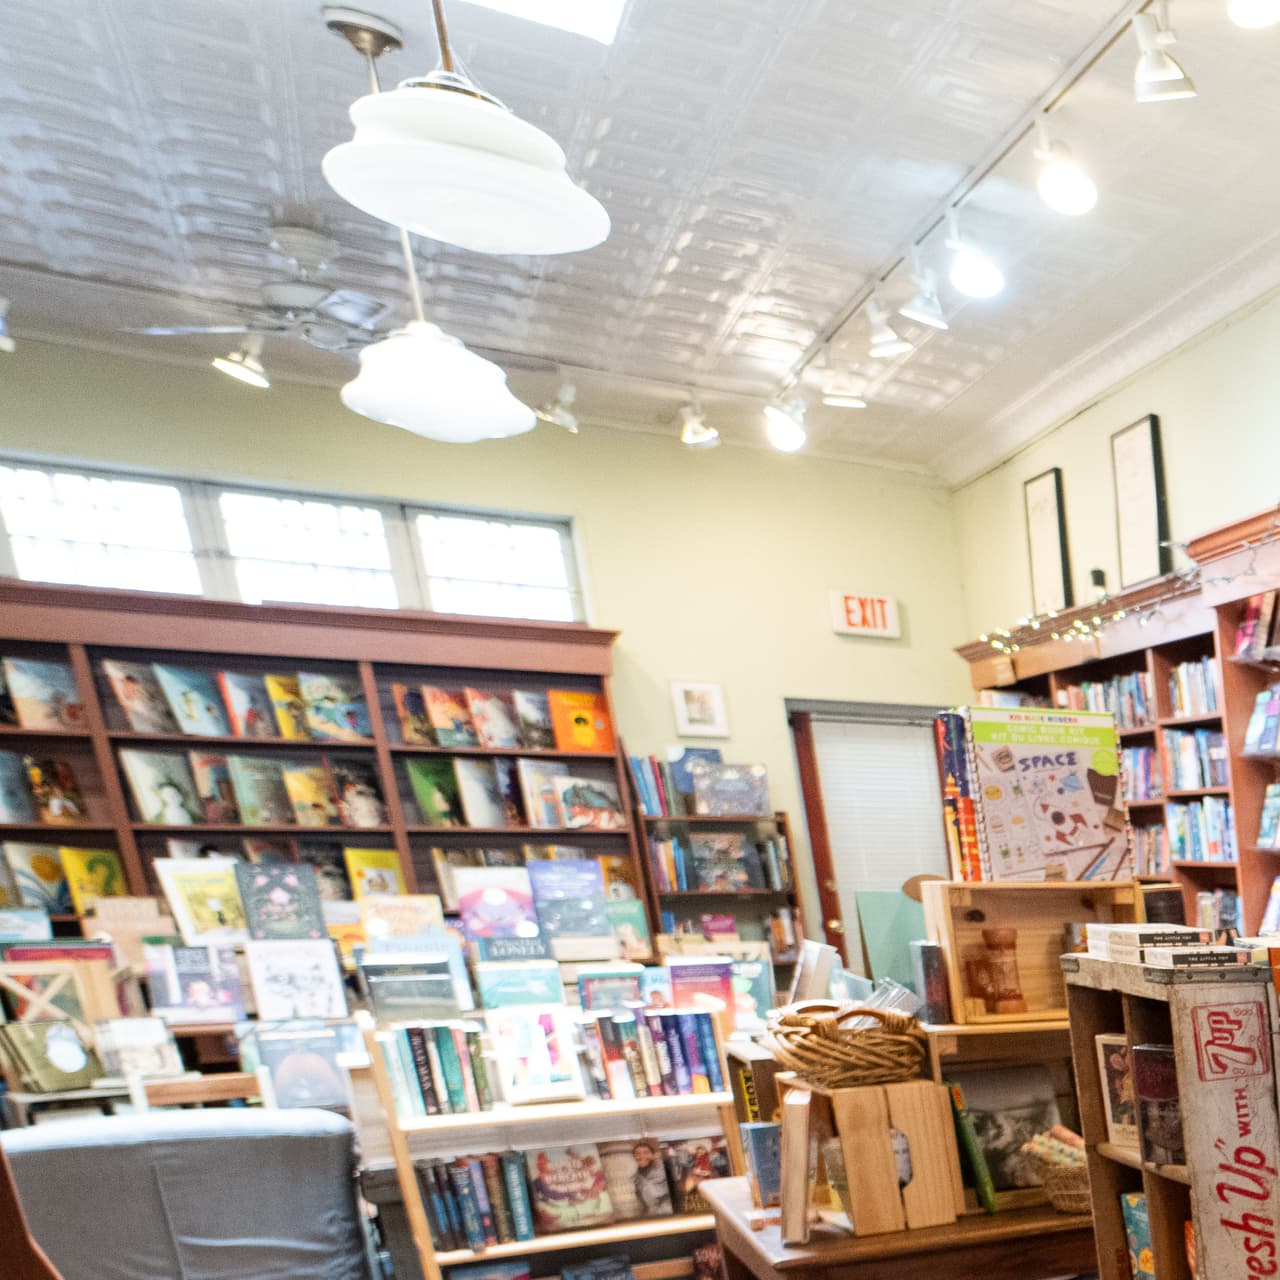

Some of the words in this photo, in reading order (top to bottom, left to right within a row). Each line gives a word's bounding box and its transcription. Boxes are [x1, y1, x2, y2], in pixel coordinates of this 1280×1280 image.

[843, 595, 889, 630] EXIT
[1018, 752, 1077, 772] SPACE
[1234, 1088, 1251, 1138] WITH
